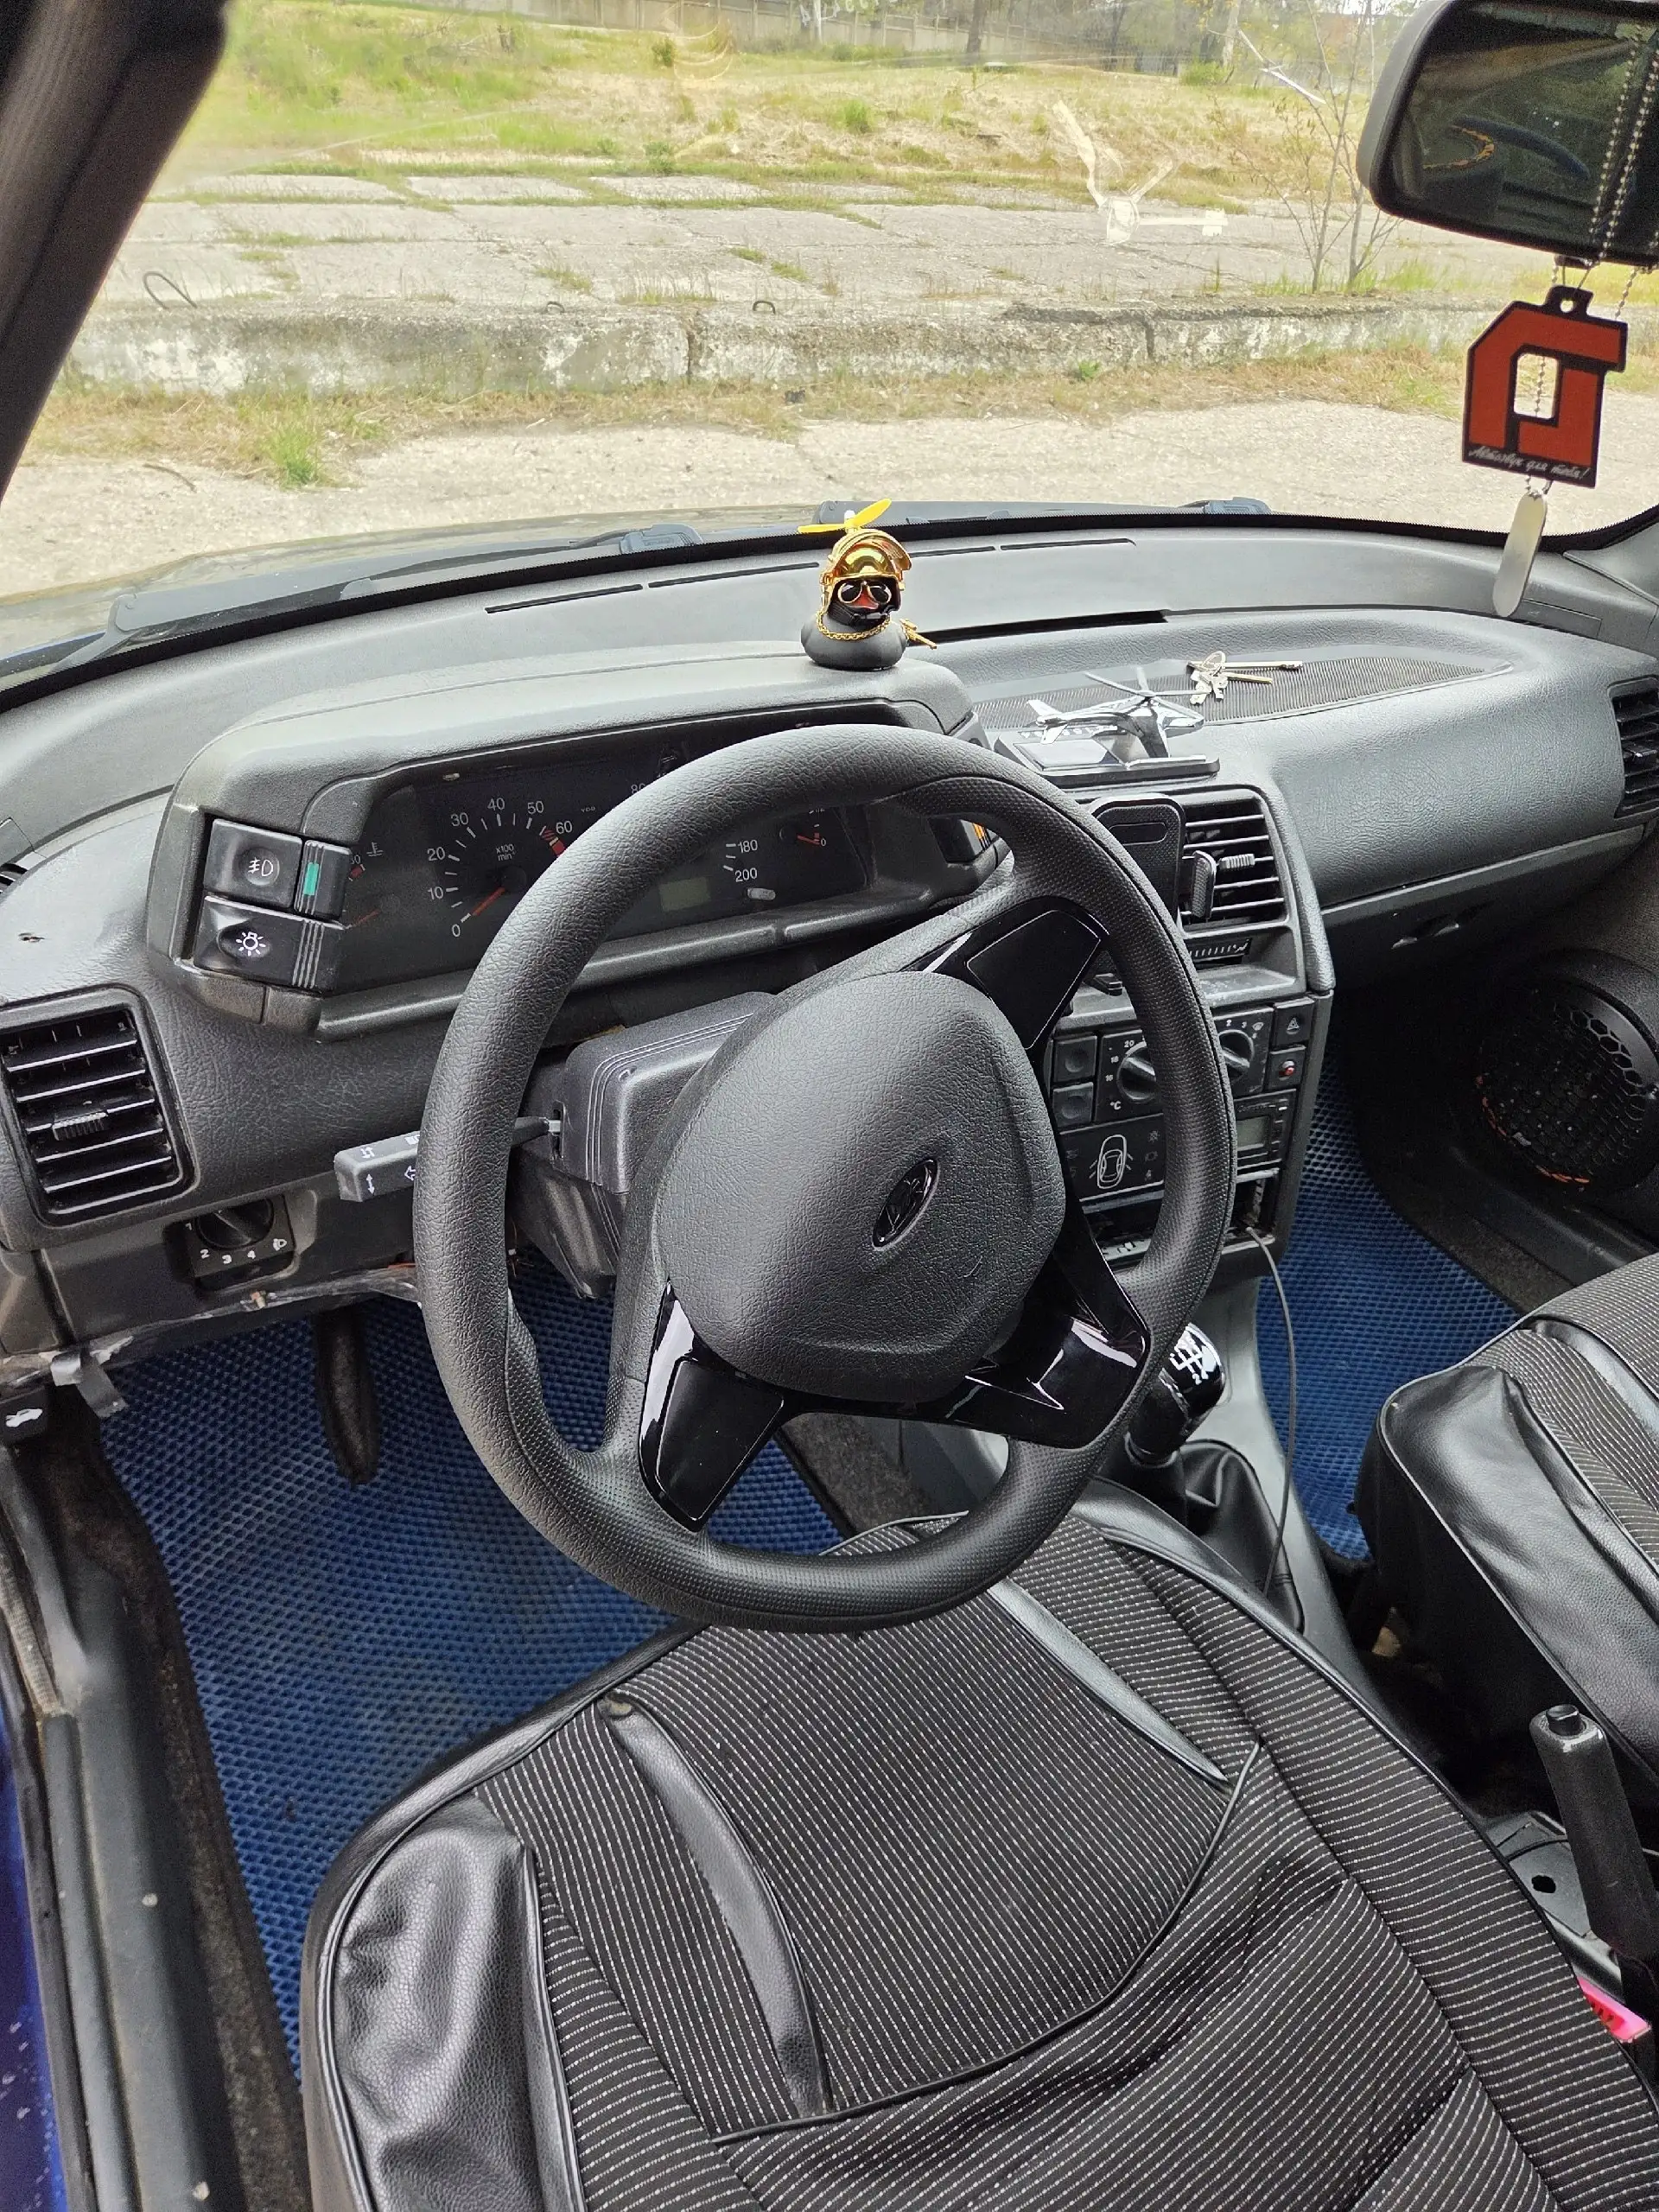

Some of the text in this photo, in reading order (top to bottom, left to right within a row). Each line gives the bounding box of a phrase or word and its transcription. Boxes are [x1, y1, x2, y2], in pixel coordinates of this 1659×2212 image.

[487, 798, 505, 810] 40
[527, 800, 544, 814] 50
[450, 812, 468, 827] 30
[556, 820, 573, 834] 60
[737, 839, 759, 854] 180
[820, 837, 827, 847] 0
[427, 846, 446, 861] 20
[734, 867, 758, 882] 200
[428, 886, 444, 899] 10
[451, 924, 461, 938] 0
[1124, 1039, 1135, 1048] 20
[200, 1249, 210, 1259] 2
[221, 1254, 232, 1264] 3
[247, 1249, 257, 1260] 4
